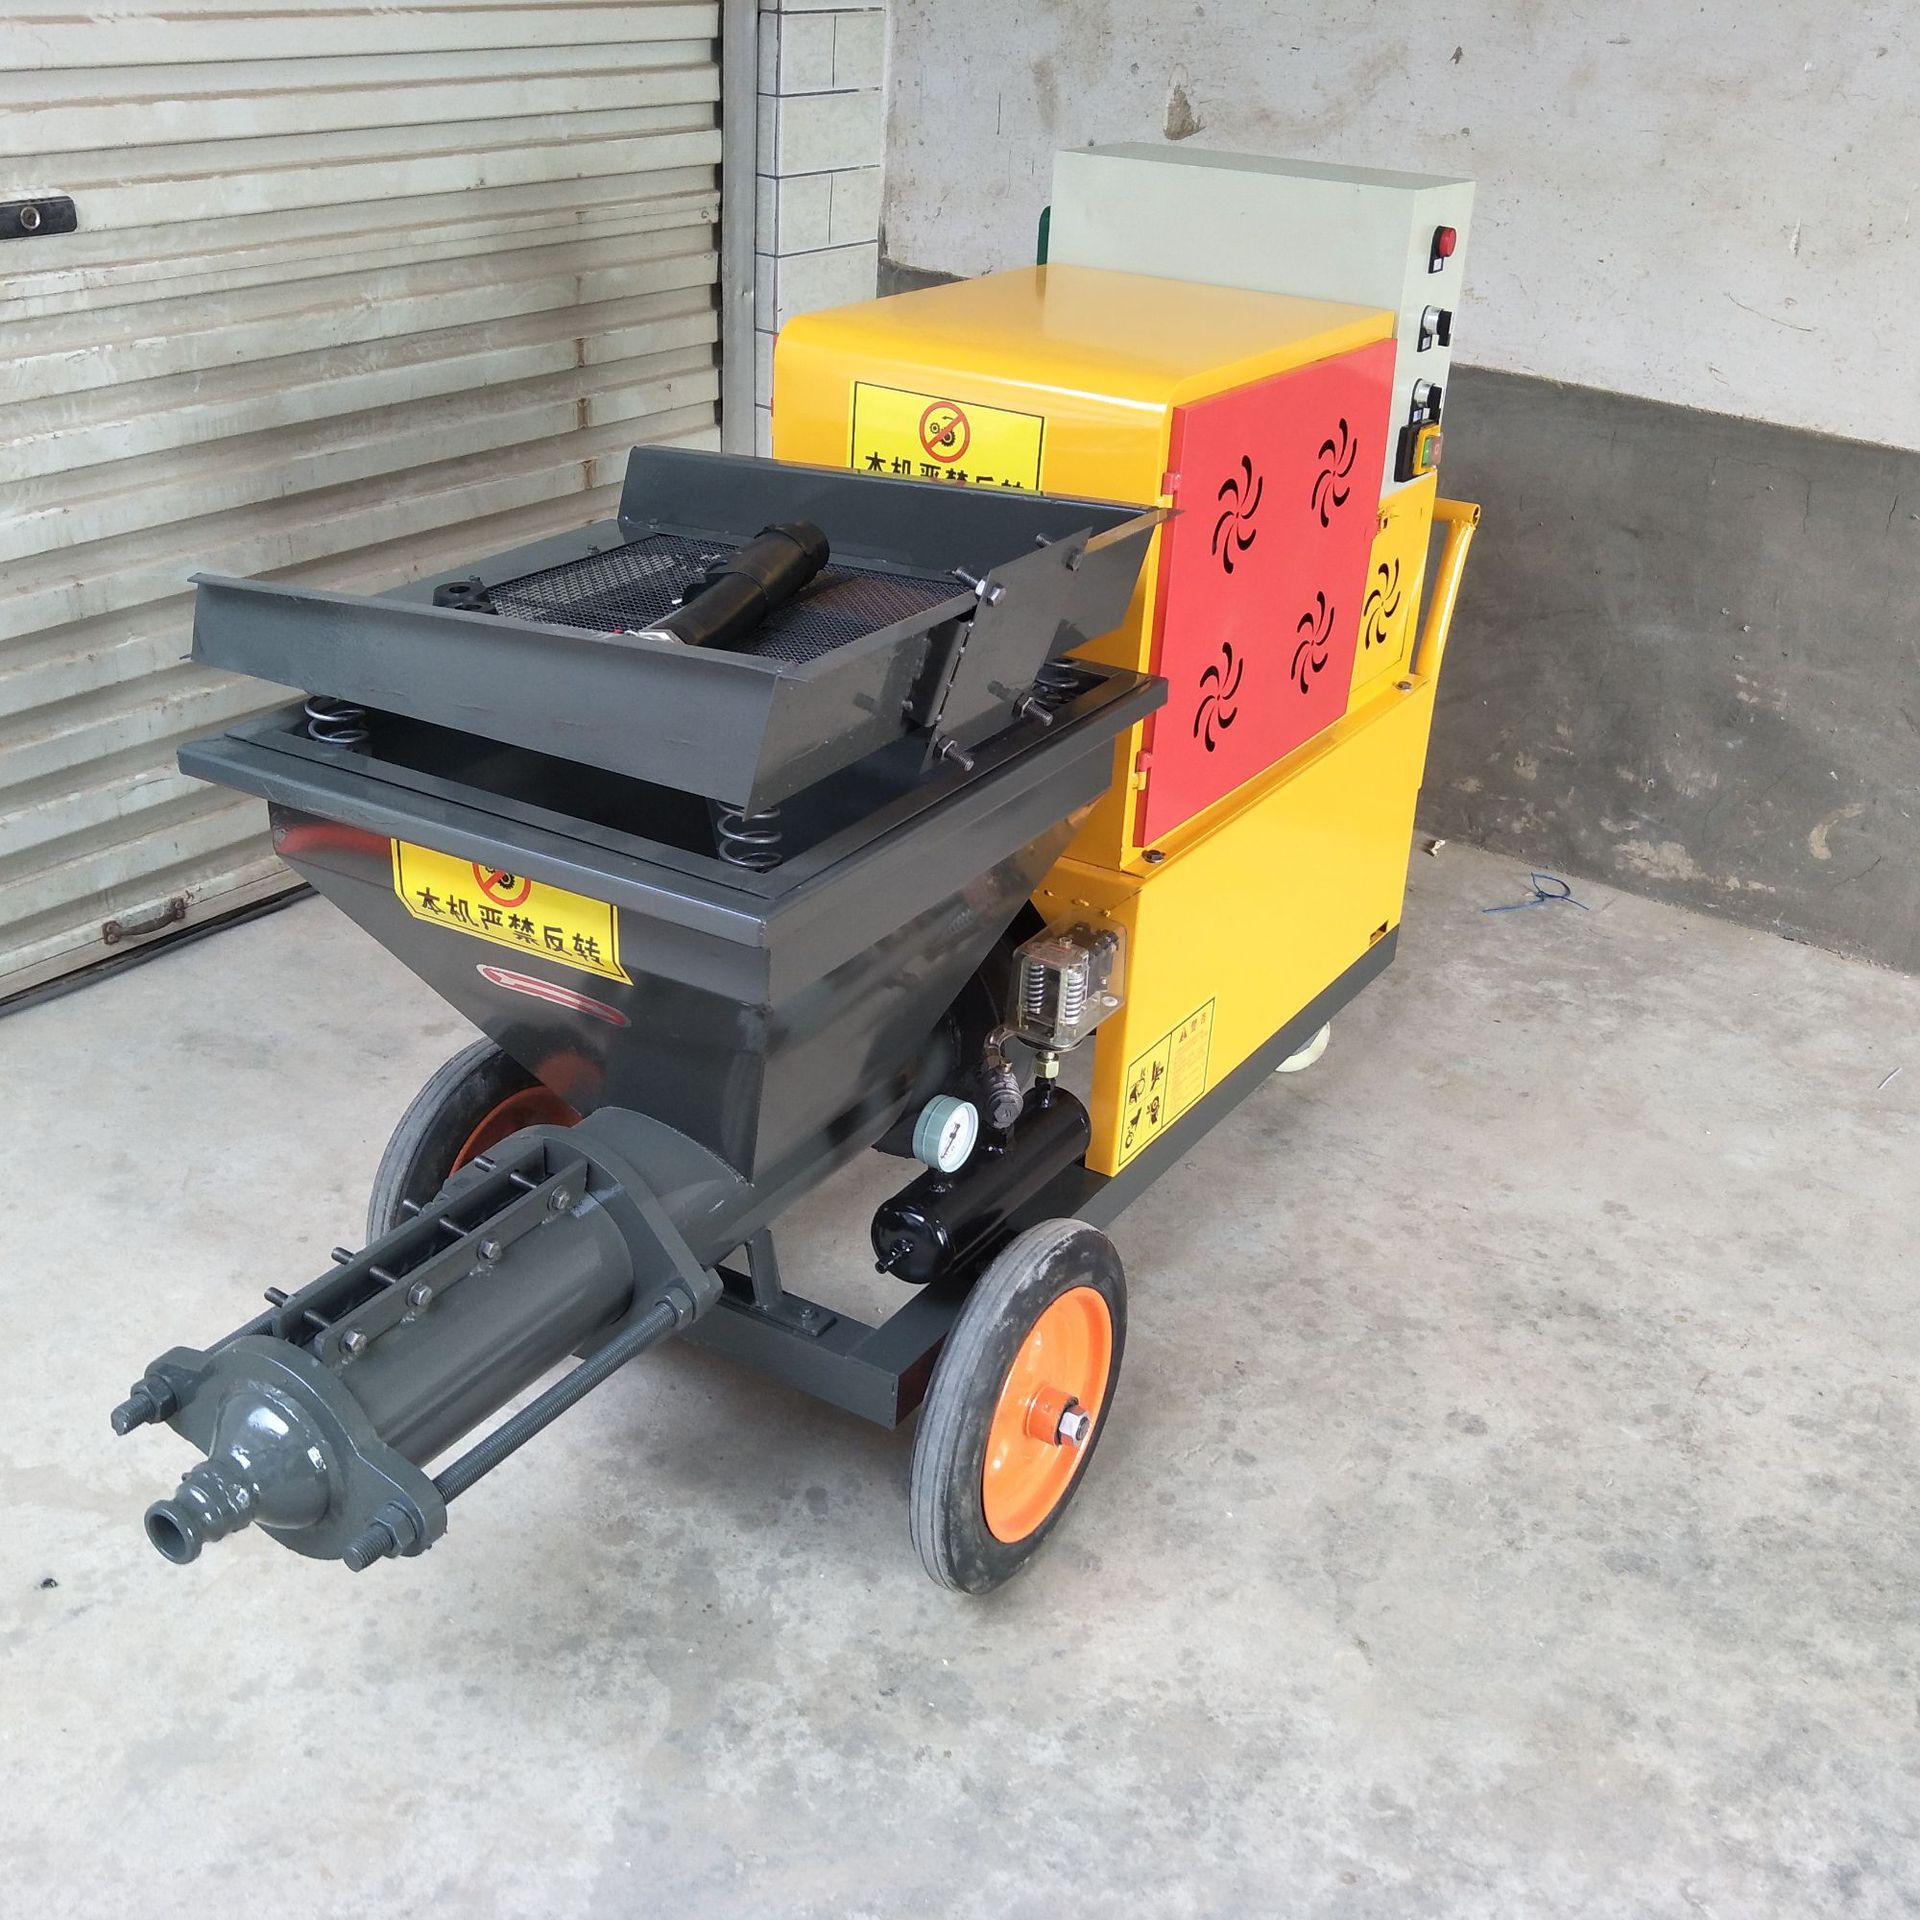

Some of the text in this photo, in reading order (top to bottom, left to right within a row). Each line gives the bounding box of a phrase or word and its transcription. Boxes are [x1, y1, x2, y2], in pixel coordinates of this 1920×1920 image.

[416, 887, 605, 966] 本机严禁反转
